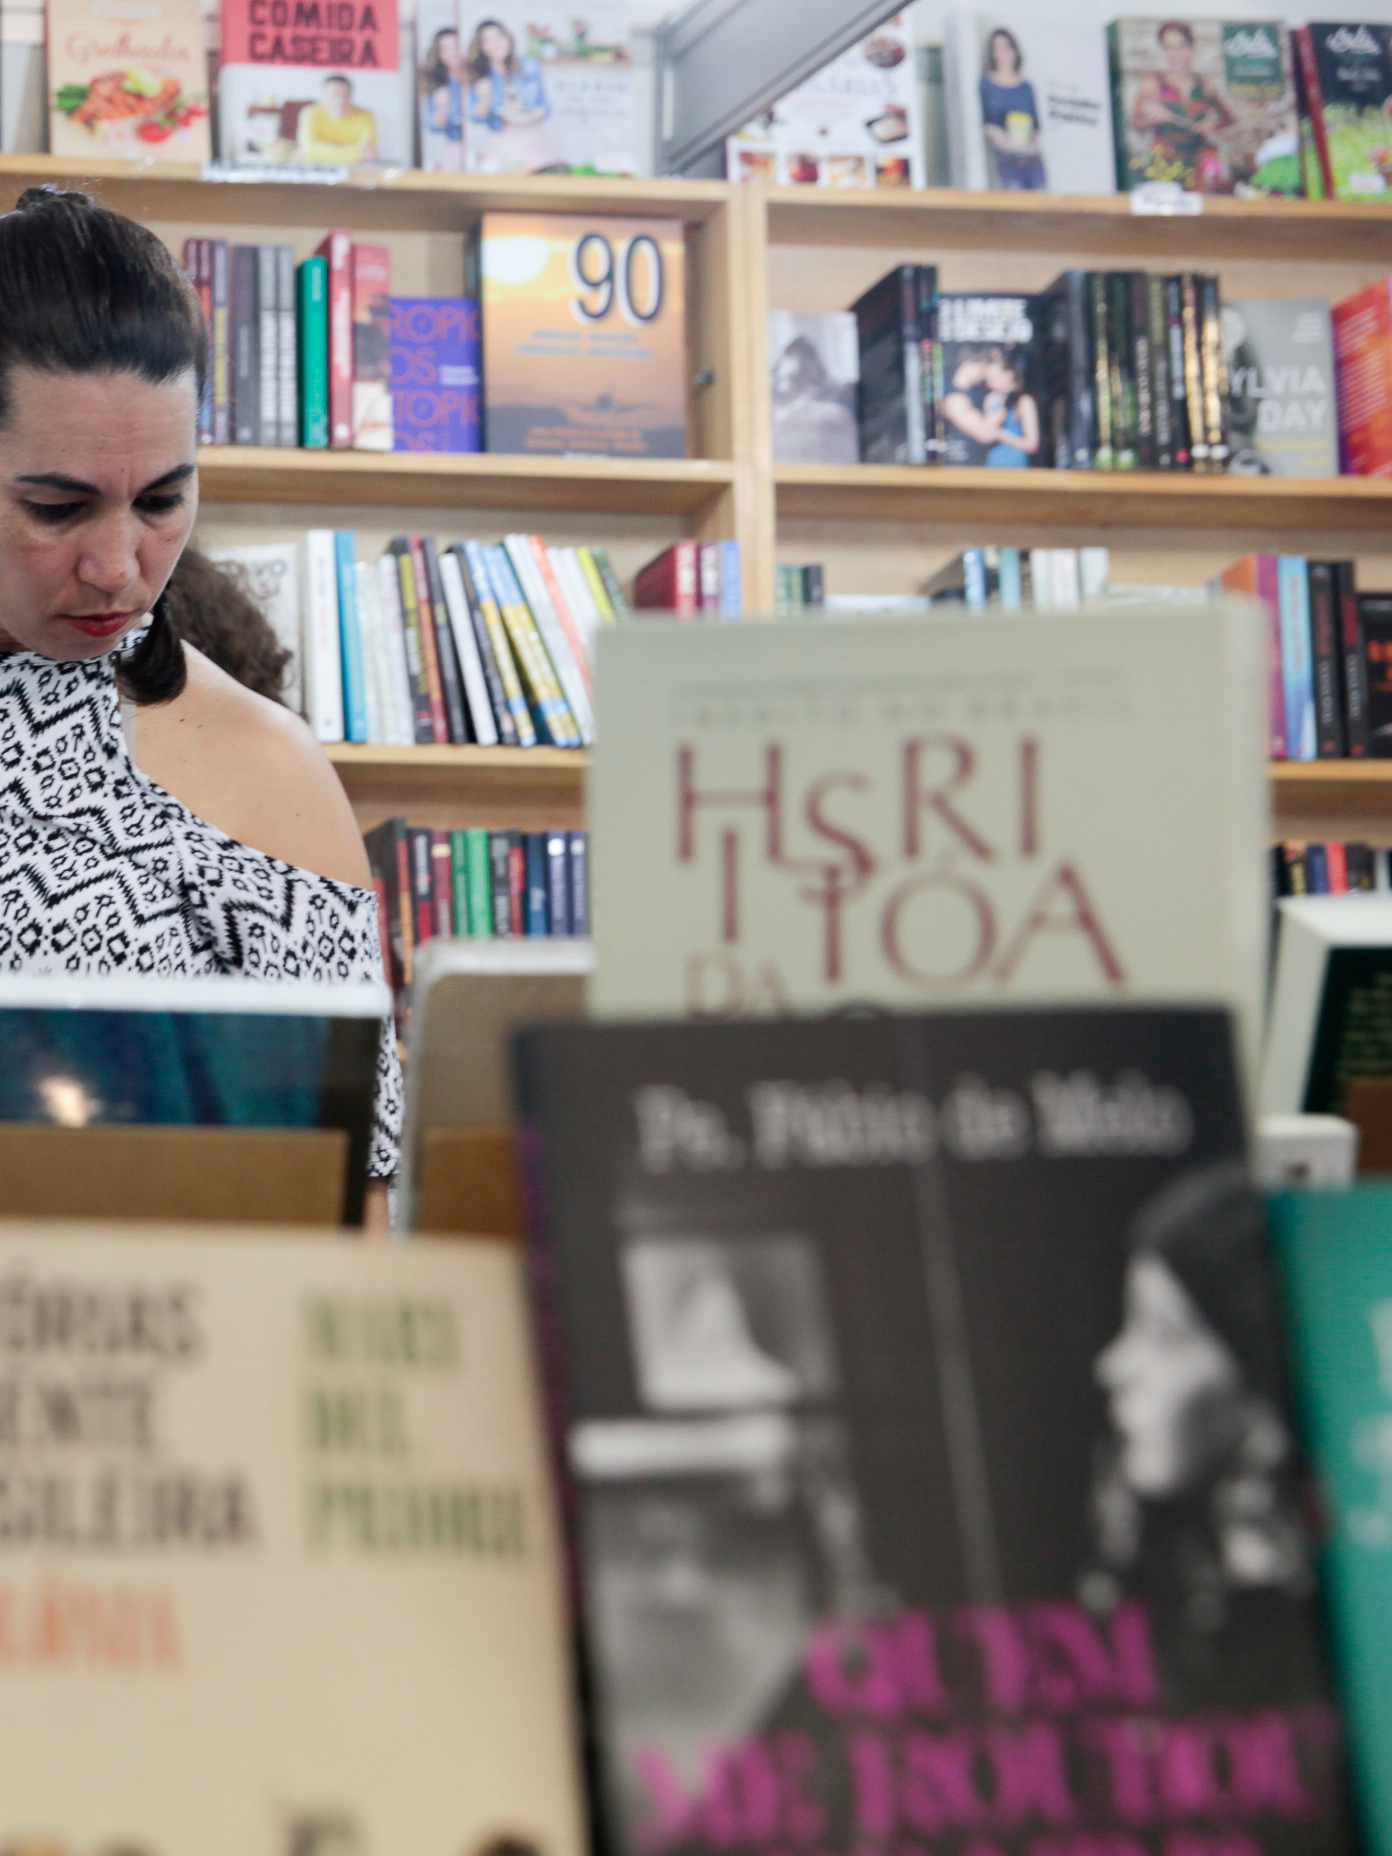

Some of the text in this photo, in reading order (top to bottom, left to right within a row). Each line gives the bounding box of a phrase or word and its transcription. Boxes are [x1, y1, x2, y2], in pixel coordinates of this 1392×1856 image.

[249, 0, 377, 31] COMIDA
[249, 33, 378, 66] CASEIRA
[572, 231, 665, 325] 90
[1229, 364, 1327, 399] YLVIA
[1259, 401, 1328, 433] DAY
